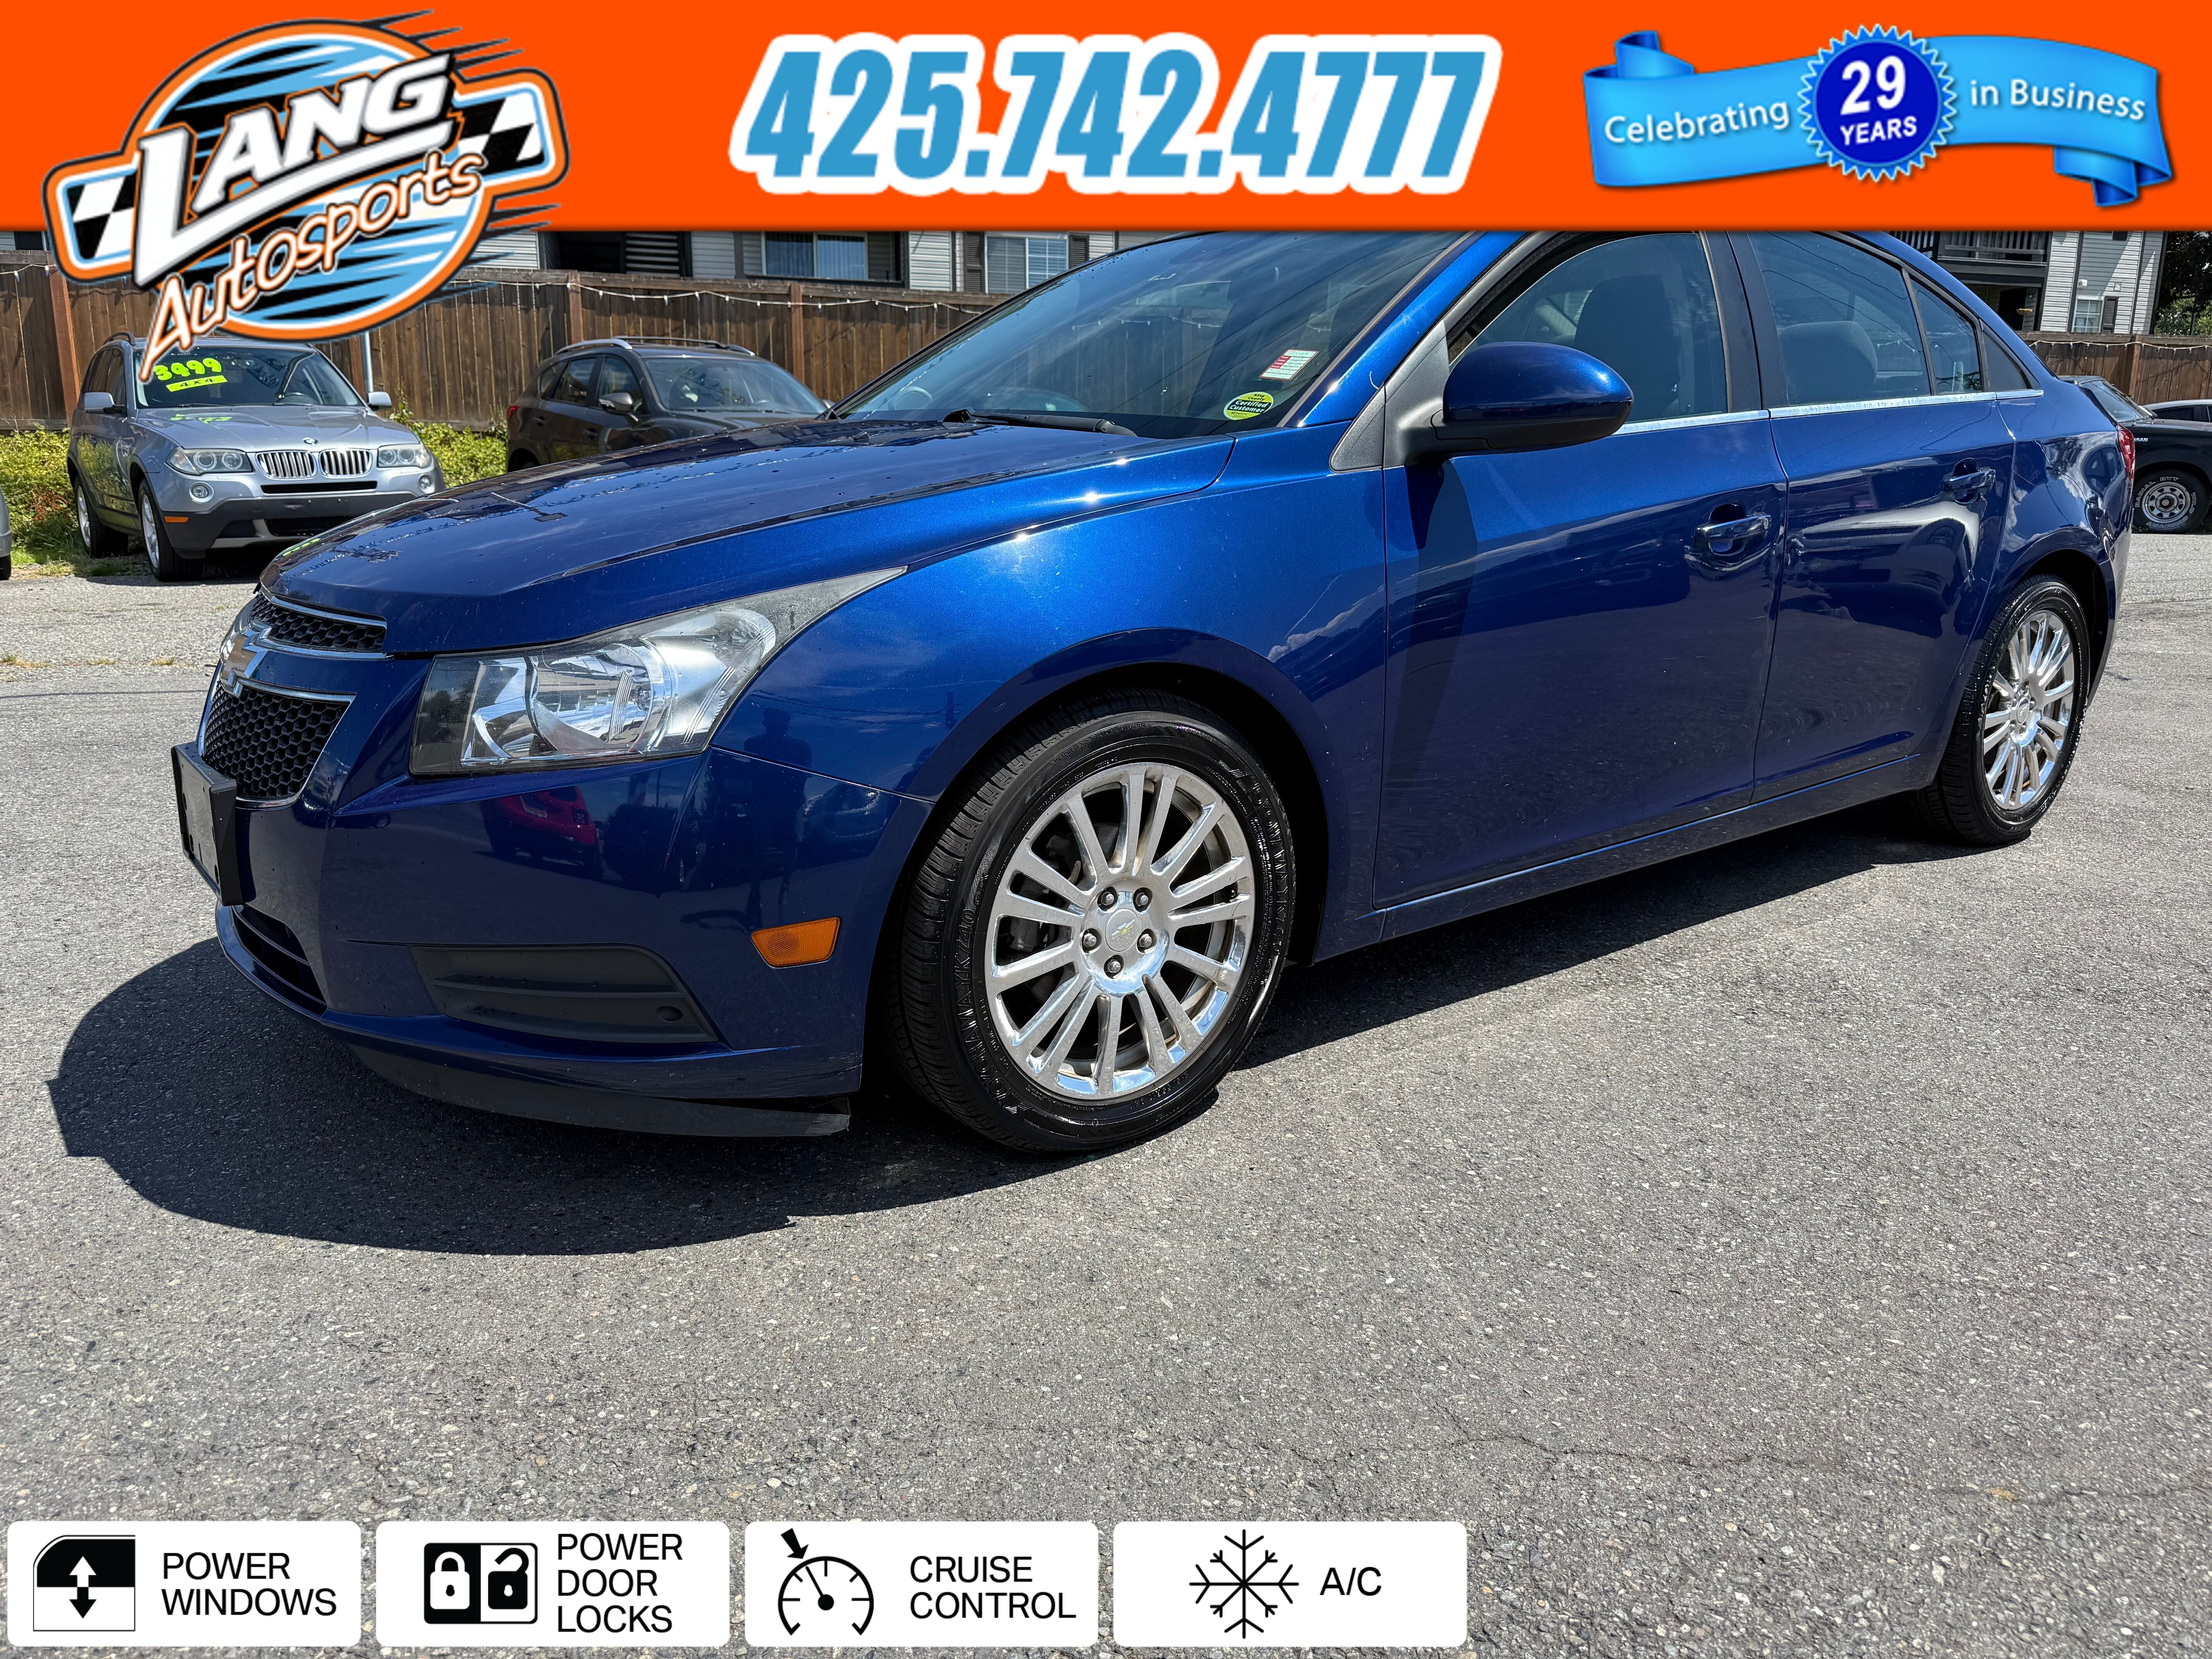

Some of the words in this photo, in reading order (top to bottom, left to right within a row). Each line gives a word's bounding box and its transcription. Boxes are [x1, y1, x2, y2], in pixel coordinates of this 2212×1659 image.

[1229, 405, 1265, 413] Customer
[1248, 776, 1288, 886] YOKOHAMA
[956, 990, 1012, 1101] YOKOHAMA
